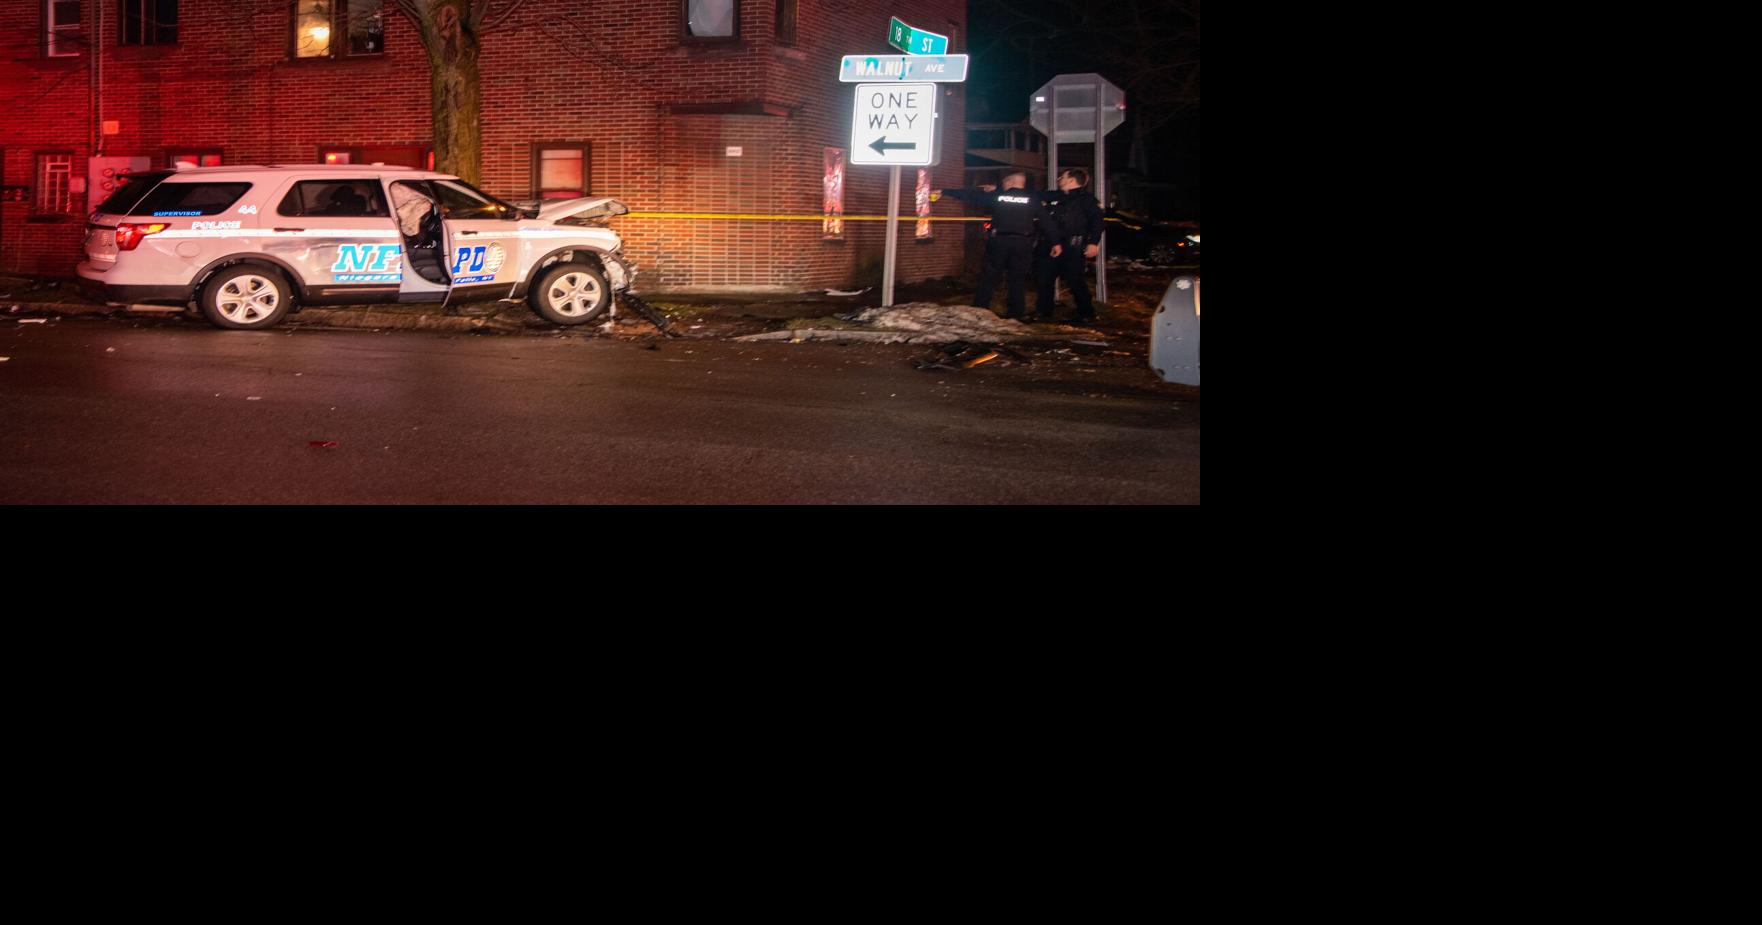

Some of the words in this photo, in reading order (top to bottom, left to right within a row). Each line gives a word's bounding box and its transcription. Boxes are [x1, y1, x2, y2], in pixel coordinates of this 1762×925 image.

[921, 37, 934, 53] ST
[856, 60, 913, 77] WALNUT
[924, 63, 945, 73] AVE
[871, 92, 918, 109] ONE
[868, 113, 919, 130] WAY
[998, 195, 1029, 204] POLICE
[191, 221, 241, 230] POLICE
[451, 245, 487, 274] PD
